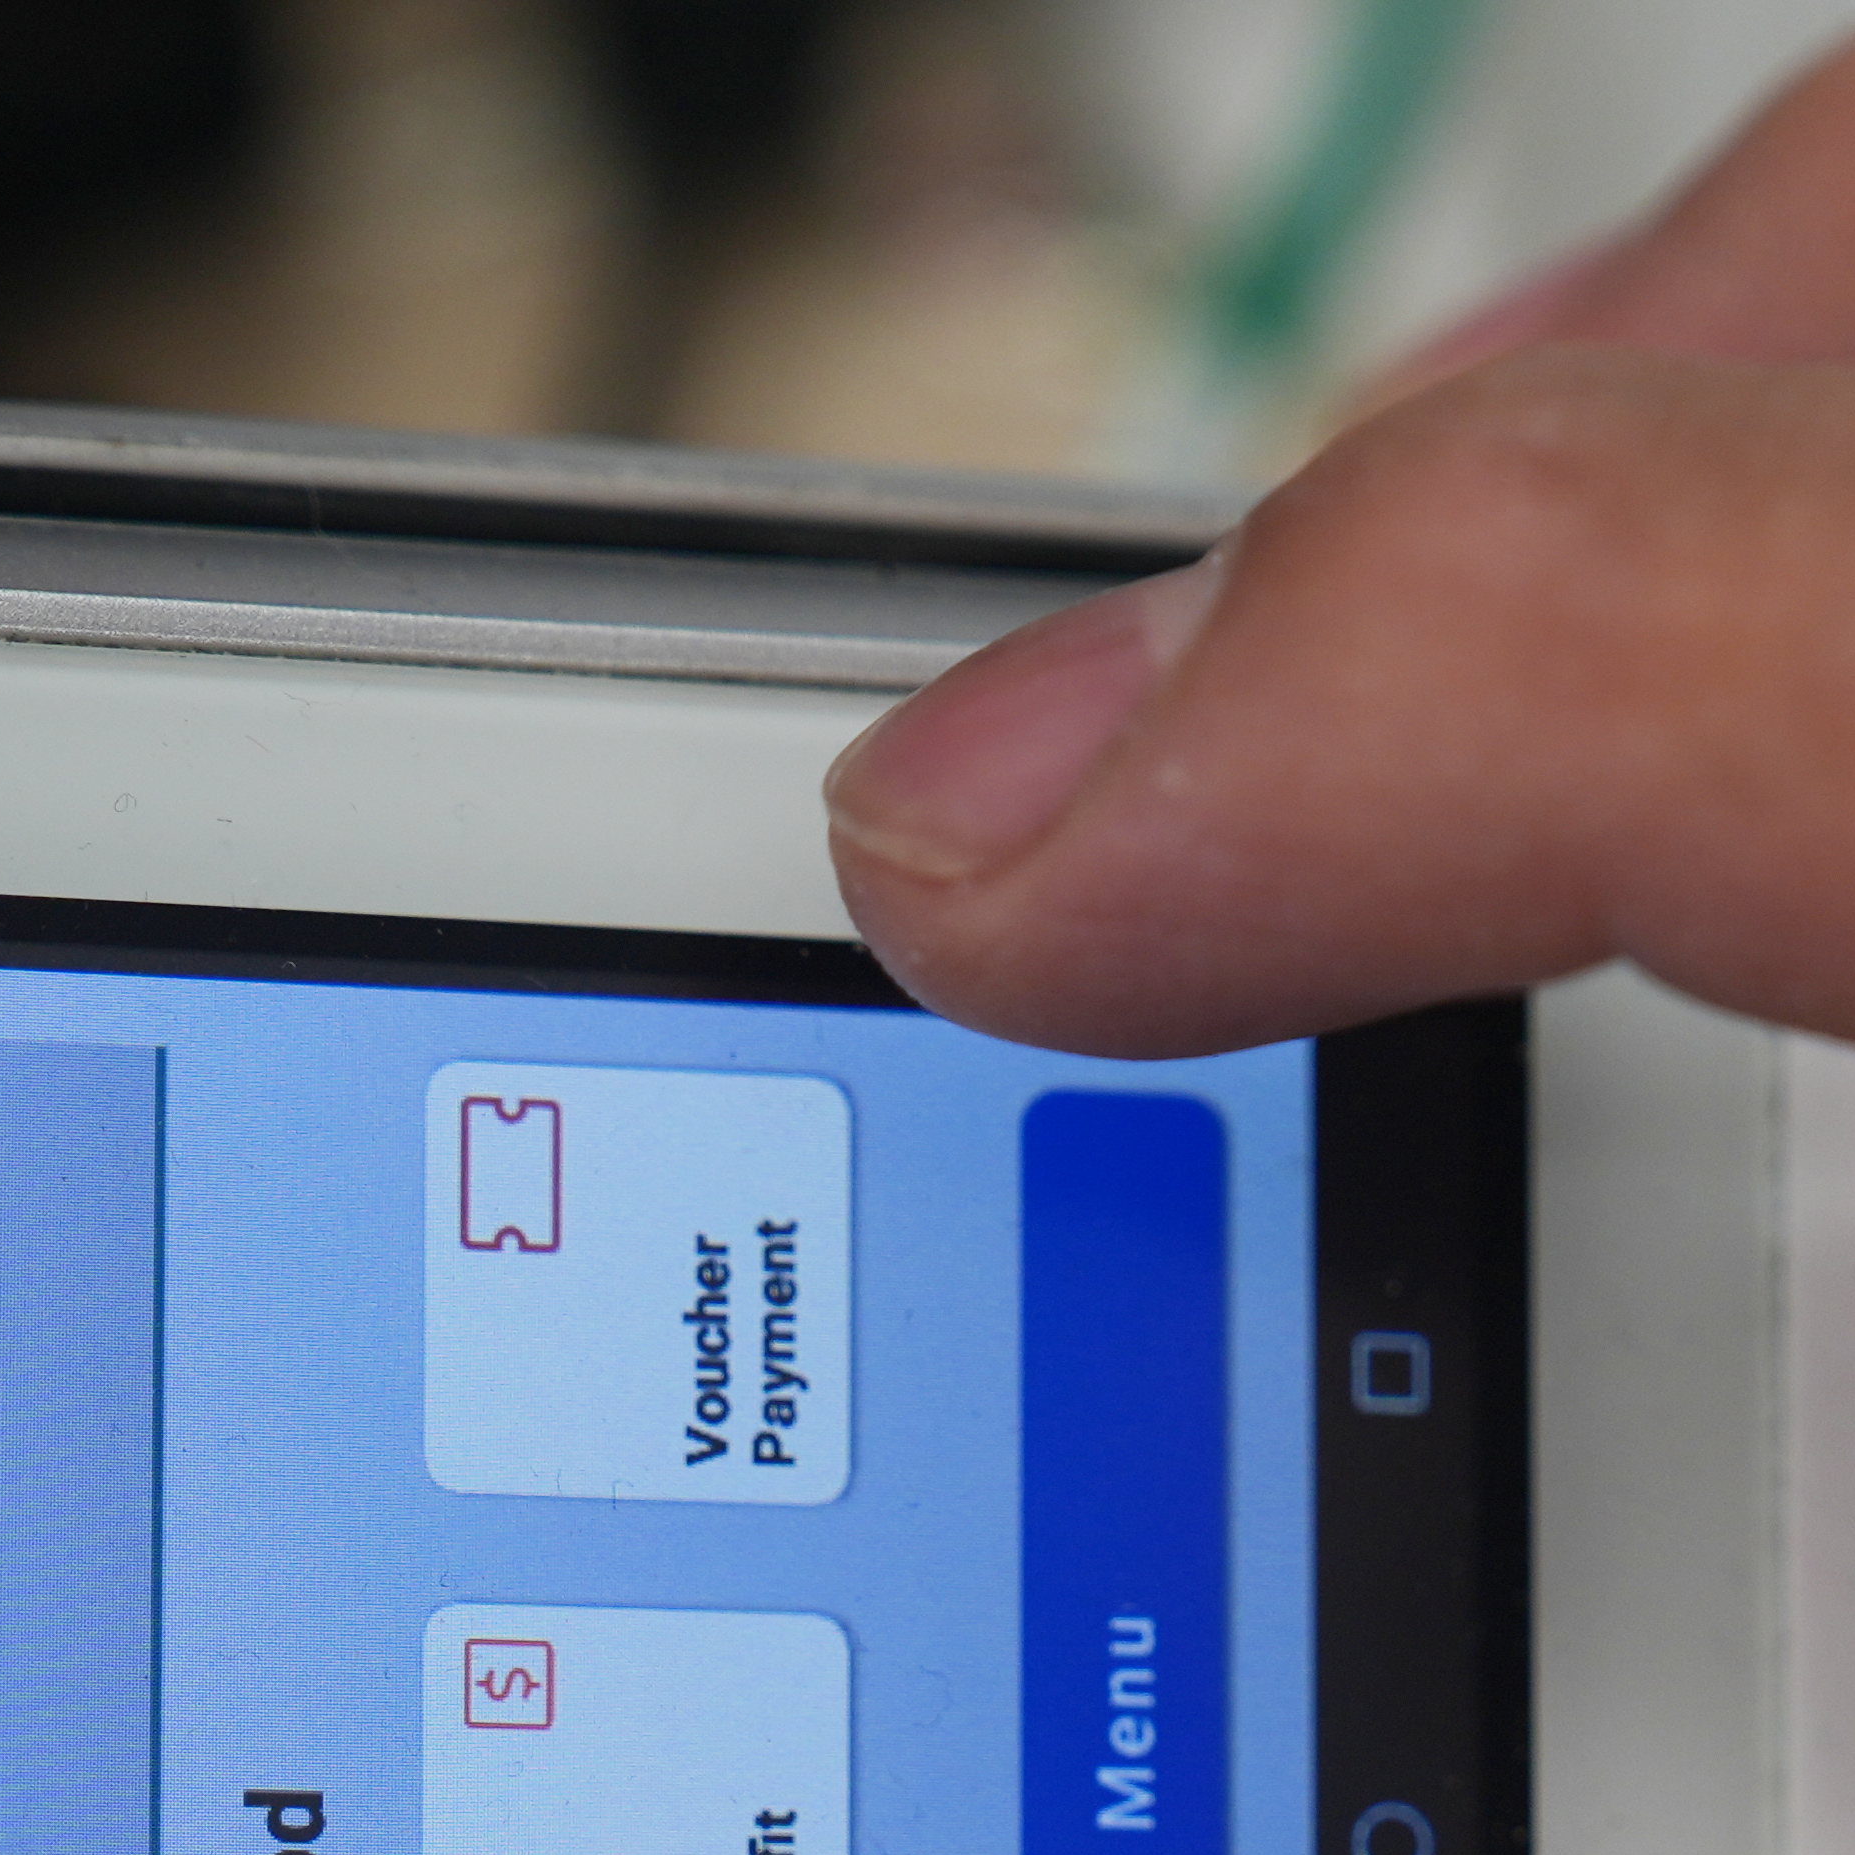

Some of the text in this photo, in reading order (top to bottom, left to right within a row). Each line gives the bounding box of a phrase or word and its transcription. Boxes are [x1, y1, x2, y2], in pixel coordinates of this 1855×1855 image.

[685, 1233, 733, 1468] Voucher
[752, 1218, 810, 1469] Payment
[1096, 1614, 1158, 1832] Menu
